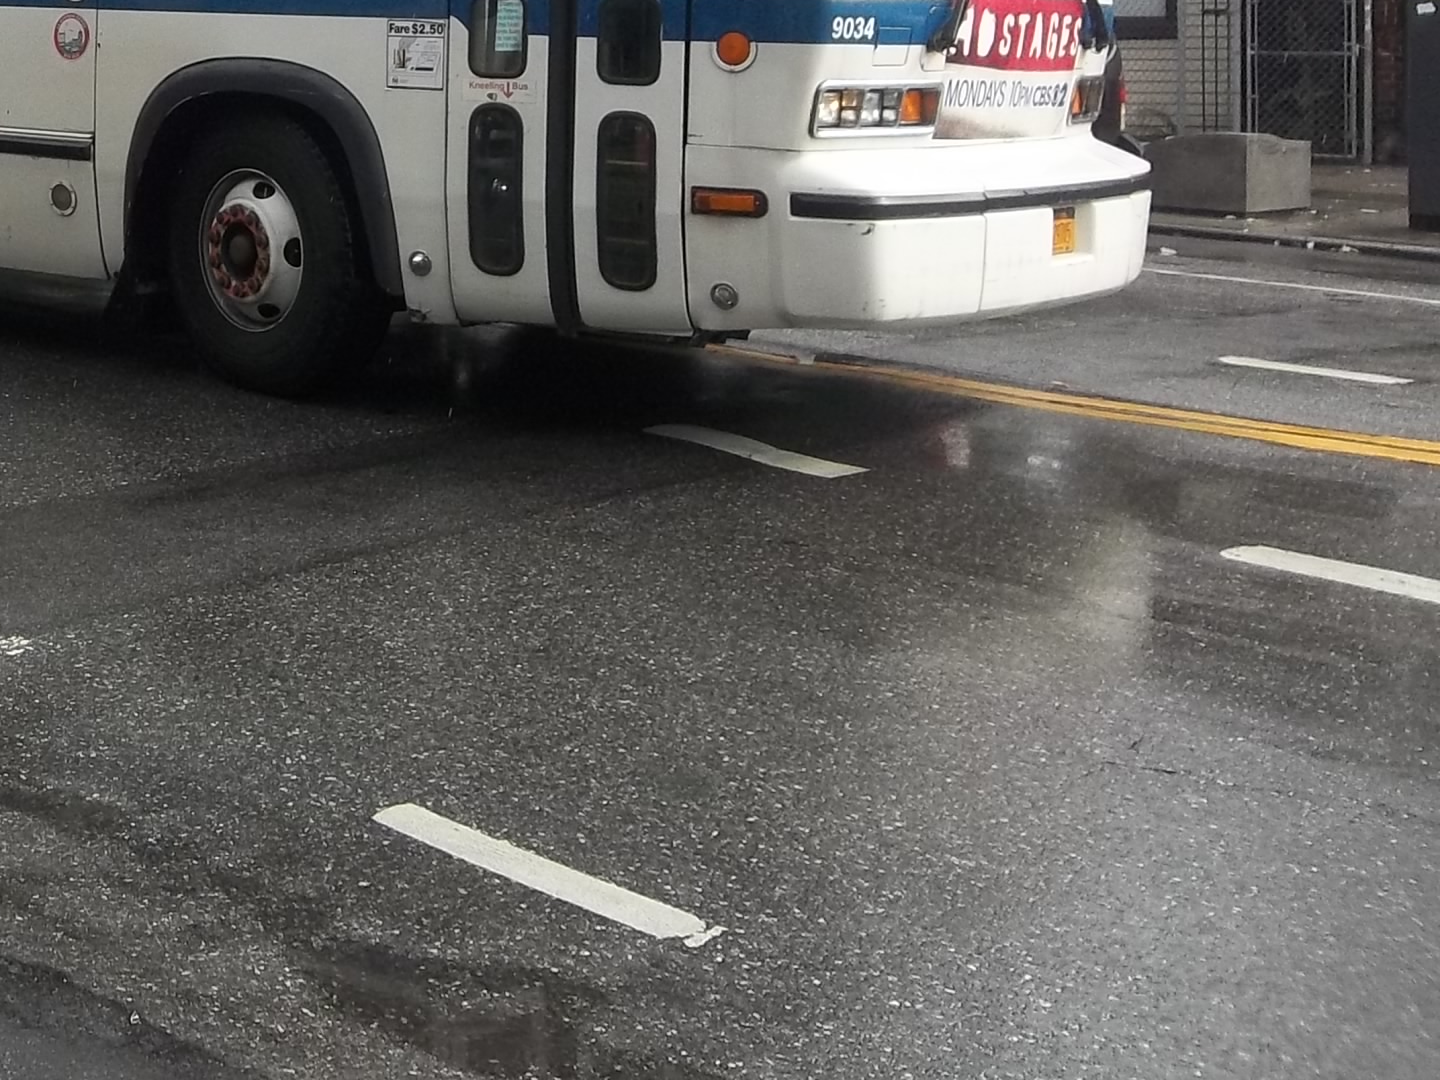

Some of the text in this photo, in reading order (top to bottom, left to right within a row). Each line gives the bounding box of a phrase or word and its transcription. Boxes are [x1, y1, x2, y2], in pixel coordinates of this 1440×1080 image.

[388, 23, 444, 35] Fare $2.50
[831, 16, 876, 40] 9034
[469, 81, 528, 92] Kneeling Bus
[944, 79, 1007, 107] MONDAYS
